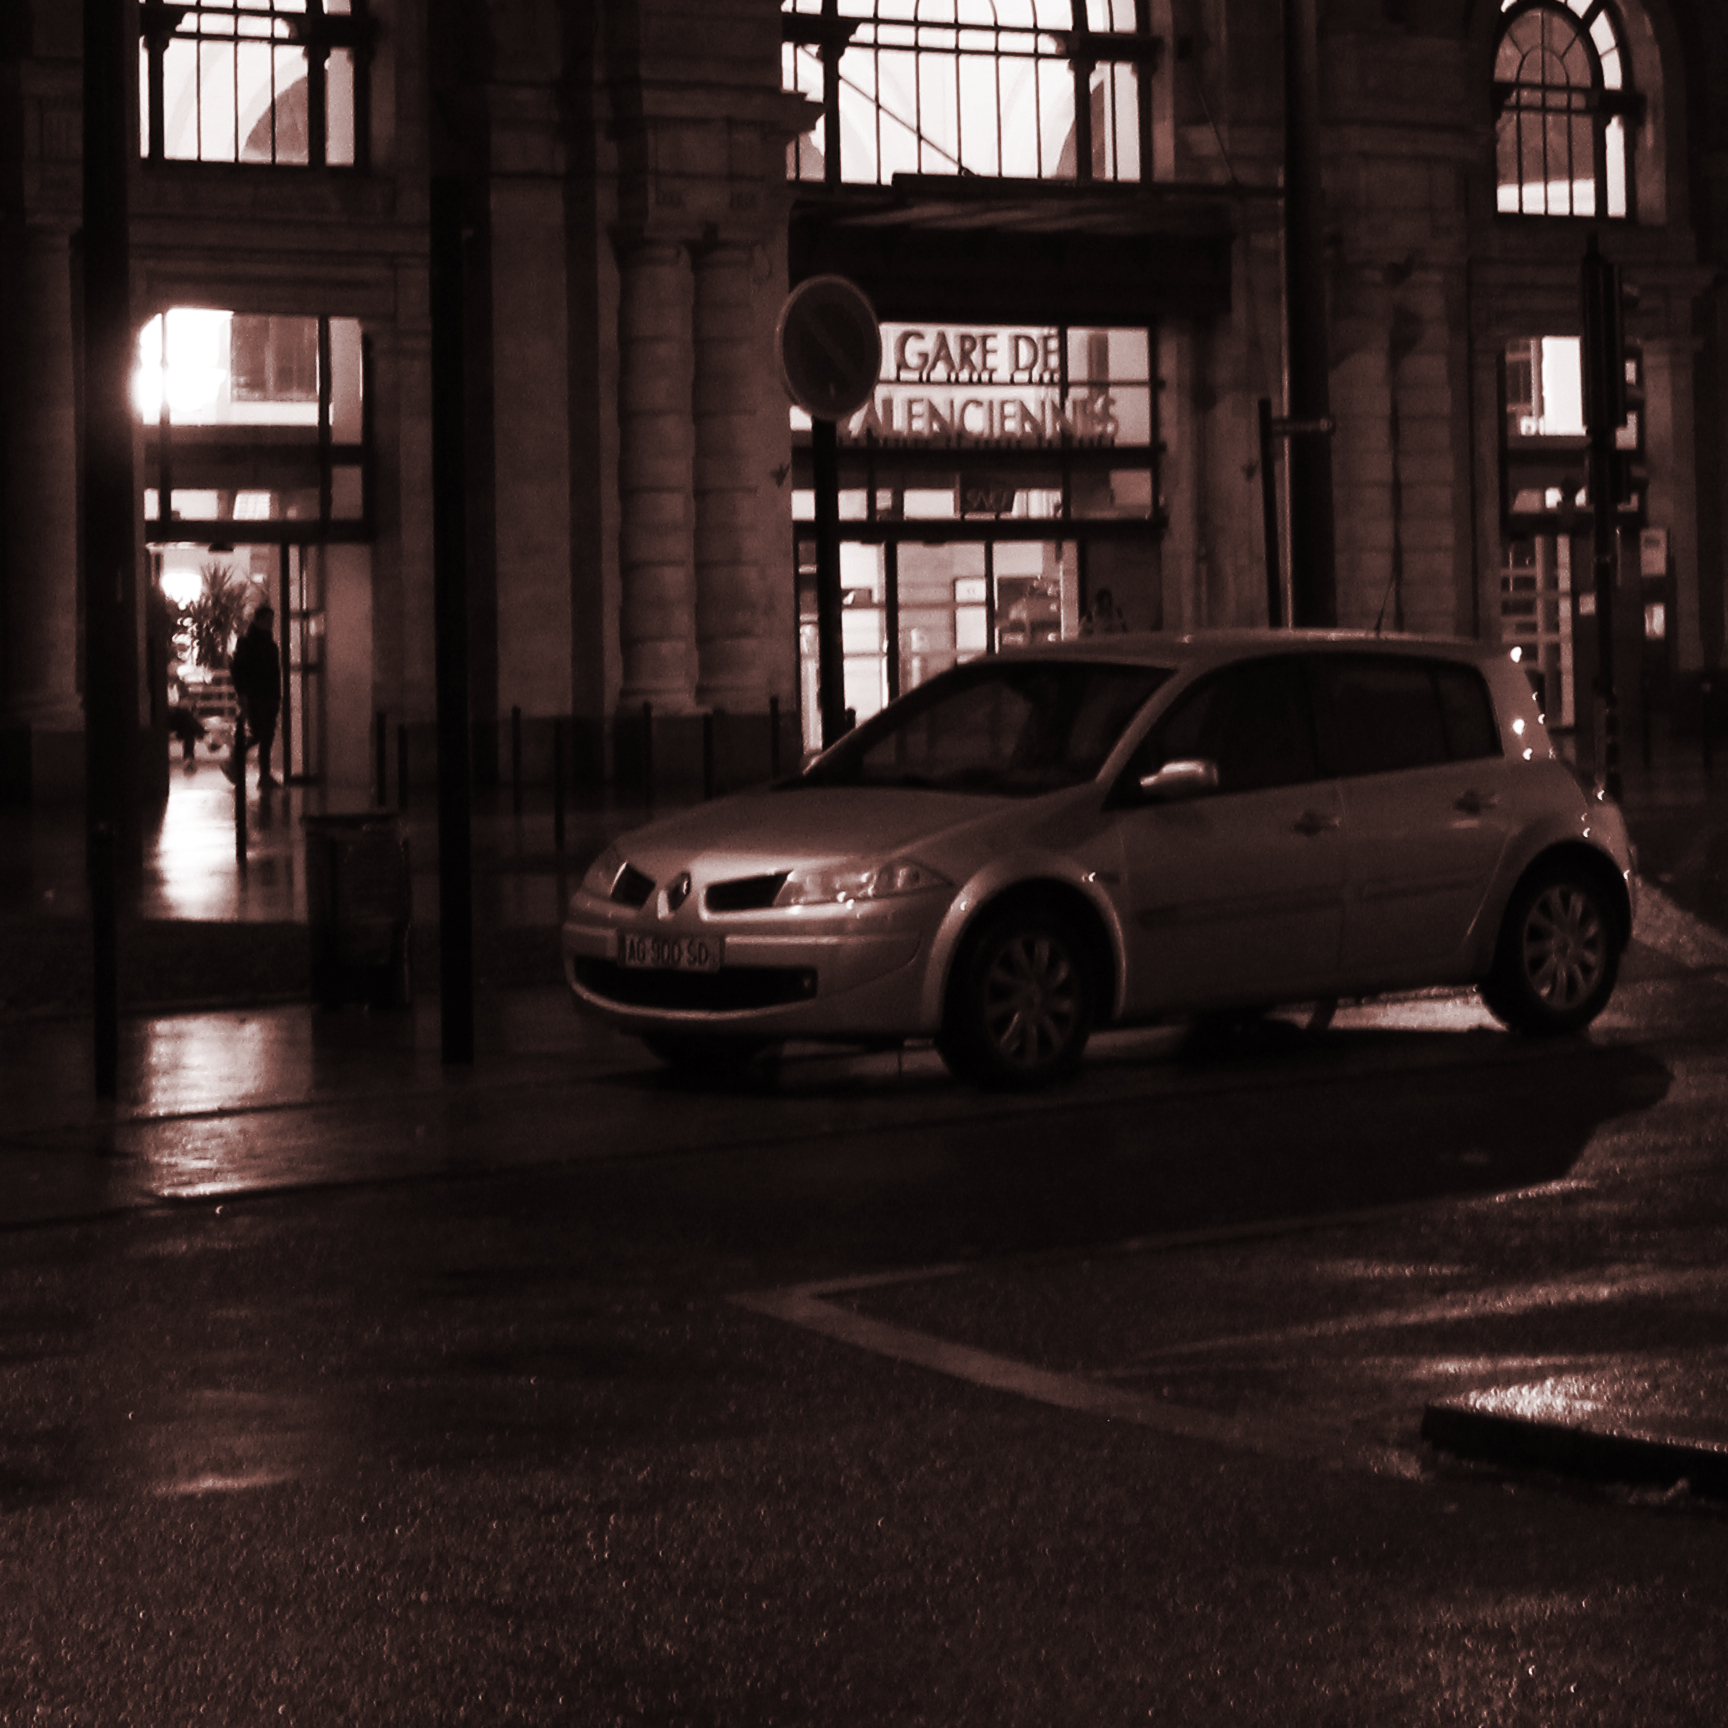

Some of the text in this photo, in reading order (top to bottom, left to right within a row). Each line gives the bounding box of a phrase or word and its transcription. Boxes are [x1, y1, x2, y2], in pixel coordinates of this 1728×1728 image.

[894, 330, 1059, 373] GARE DE
[840, 394, 1119, 438] ALENCIENNES
